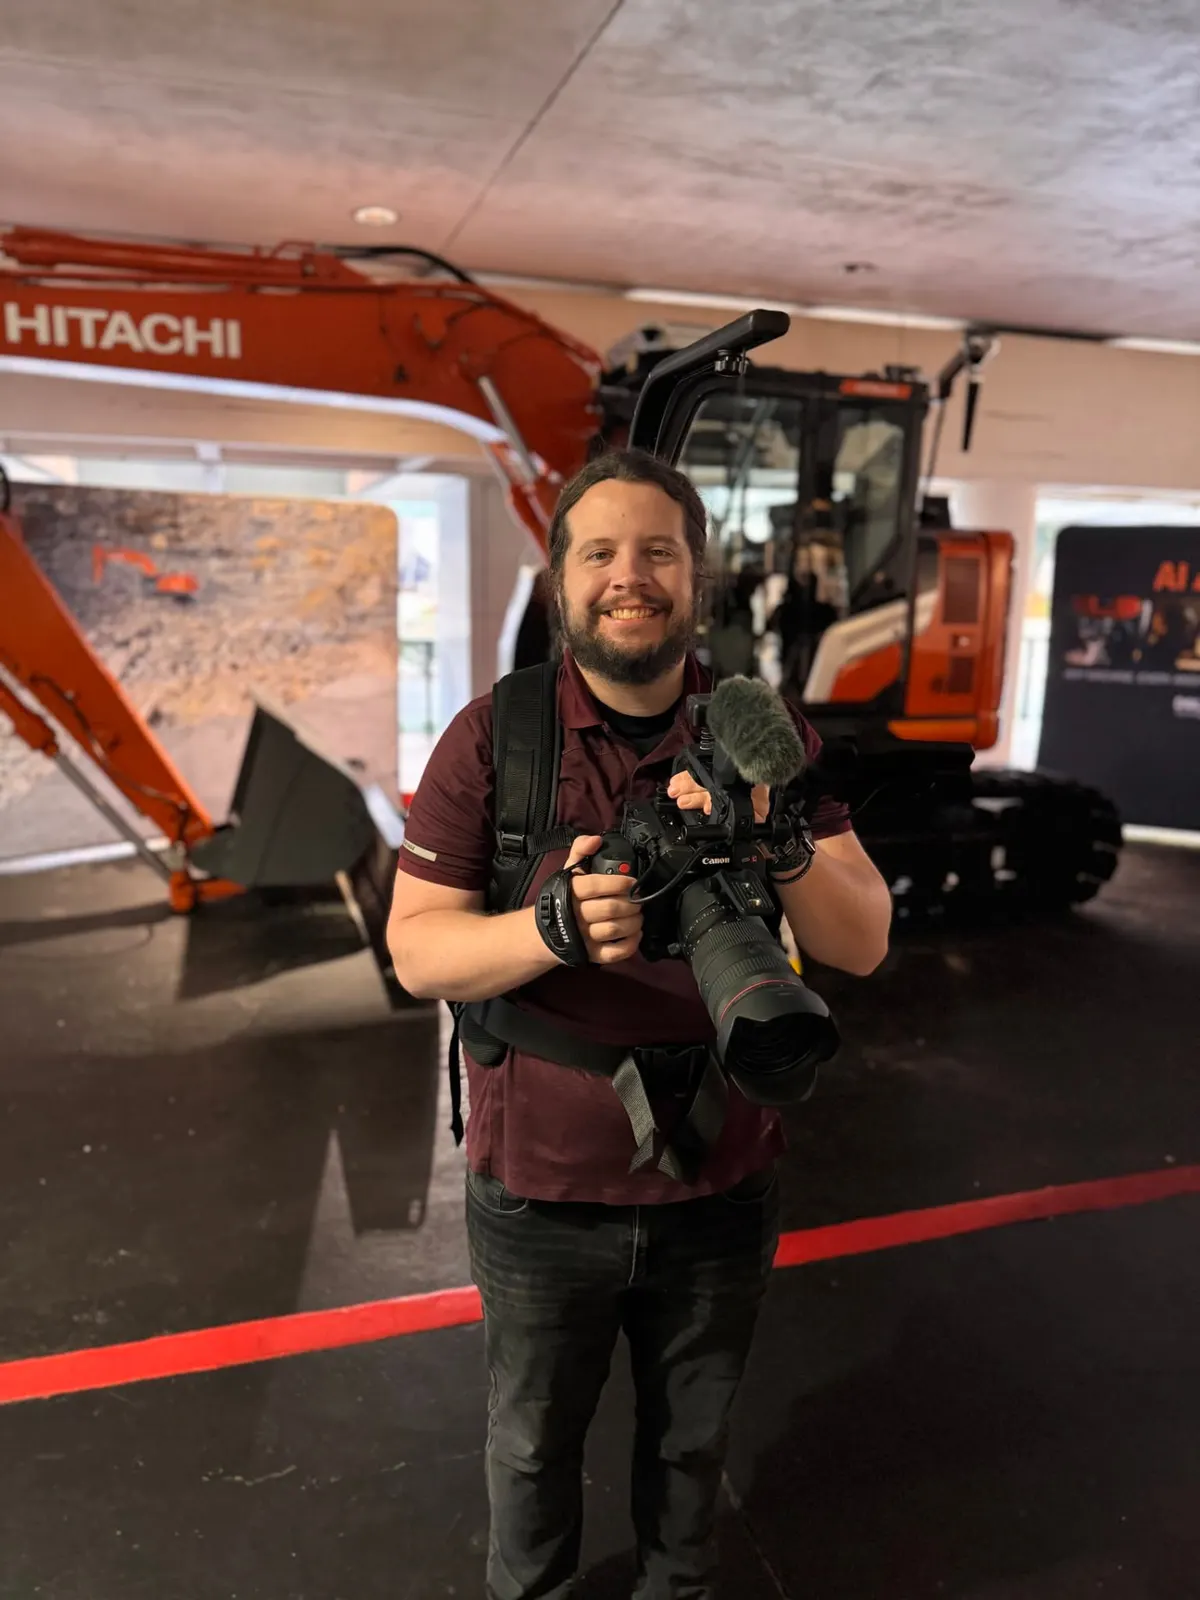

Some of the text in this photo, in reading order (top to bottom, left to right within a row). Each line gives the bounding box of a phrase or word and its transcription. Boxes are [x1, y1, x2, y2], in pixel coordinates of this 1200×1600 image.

[4, 302, 242, 359] HITACHI
[1152, 560, 1189, 592] AI
[702, 857, 730, 865] Canon
[555, 898, 570, 943] Canon
